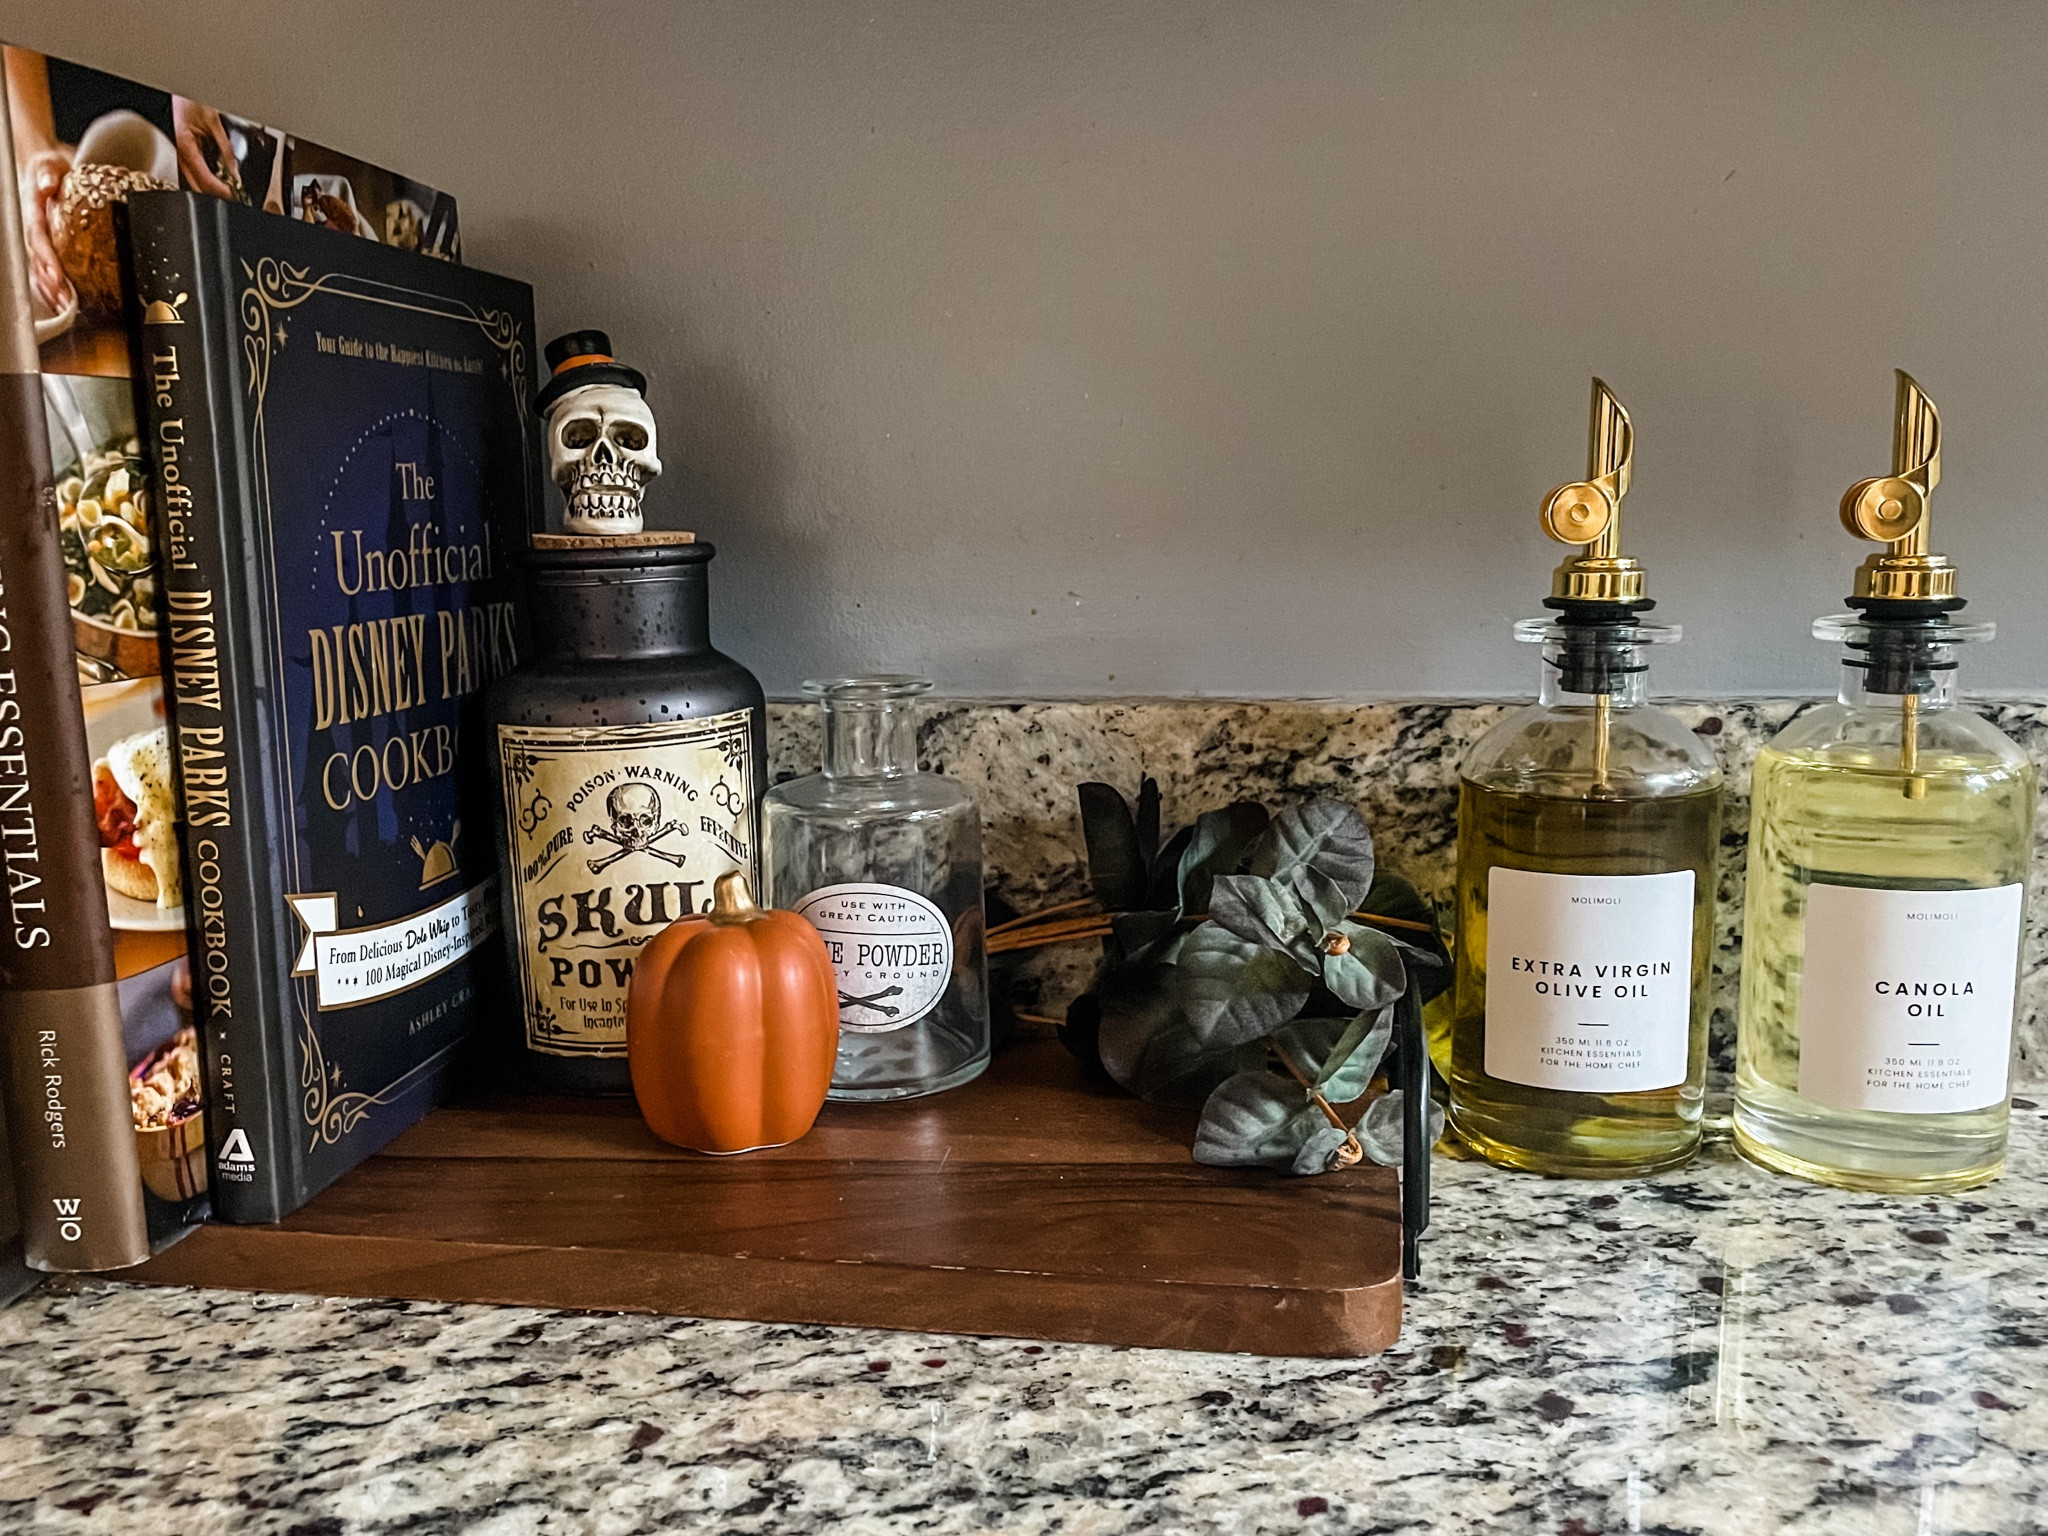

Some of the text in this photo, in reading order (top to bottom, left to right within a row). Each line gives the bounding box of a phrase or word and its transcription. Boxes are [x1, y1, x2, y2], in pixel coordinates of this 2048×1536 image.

[315, 331, 336, 354] Your
[338, 336, 363, 357] Guide
[365, 341, 374, 359] to
[376, 341, 388, 361] the
[395, 462, 435, 500] The
[331, 521, 494, 595] Unofficial
[308, 601, 518, 731] DISNEY PARKS
[152, 346, 235, 1114] The Unofficial DISNEY PARKS COOKBOOK CRAFT
[322, 724, 459, 811] COOKB
[566, 765, 699, 813] POISON WARNING
[546, 826, 574, 861] PURE
[841, 900, 906, 910] USE WITH
[1571, 896, 1621, 905] MOLIMOLI
[538, 880, 712, 952] SKUL
[819, 911, 926, 923] GREAT CAUTION
[1906, 913, 1958, 921] MOLIMOLI
[329, 947, 356, 965] From
[359, 939, 402, 962] Delicious
[405, 926, 427, 950] Dole
[428, 918, 450, 940] Whip
[452, 915, 460, 928] to
[856, 943, 943, 967] POWDER
[366, 968, 383, 986] 100
[385, 954, 421, 981] Magical
[549, 956, 638, 988] POW
[865, 970, 940, 979] GROUND
[1512, 956, 1671, 978] EXTRA VIRGIN
[1535, 981, 1648, 999] OLIVE OIL
[1875, 981, 1974, 996] CANOLA
[560, 997, 576, 1011] For
[579, 998, 598, 1012] Use
[601, 998, 612, 1013] In
[1907, 1003, 1945, 1017] OIL
[409, 999, 448, 1036] ASHLEY
[1555, 1037, 1574, 1045] 350
[1541, 1047, 1642, 1058] KITCHEN ESSENTIALS
[1540, 1058, 1559, 1066] FOR
[1564, 1060, 1581, 1068] THE
[1618, 1061, 1640, 1069] CHEF
[1884, 1058, 1905, 1066] 350
[1947, 1058, 1960, 1066] OZ
[1868, 1068, 1972, 1078] KITCHEN ESSENTIALS
[38, 1030, 66, 1148] Rick Rodgers
[1893, 1081, 1911, 1089] THE
[1948, 1080, 1970, 1089] CHEF
[218, 1161, 255, 1172] adams
[222, 1171, 252, 1182] media
